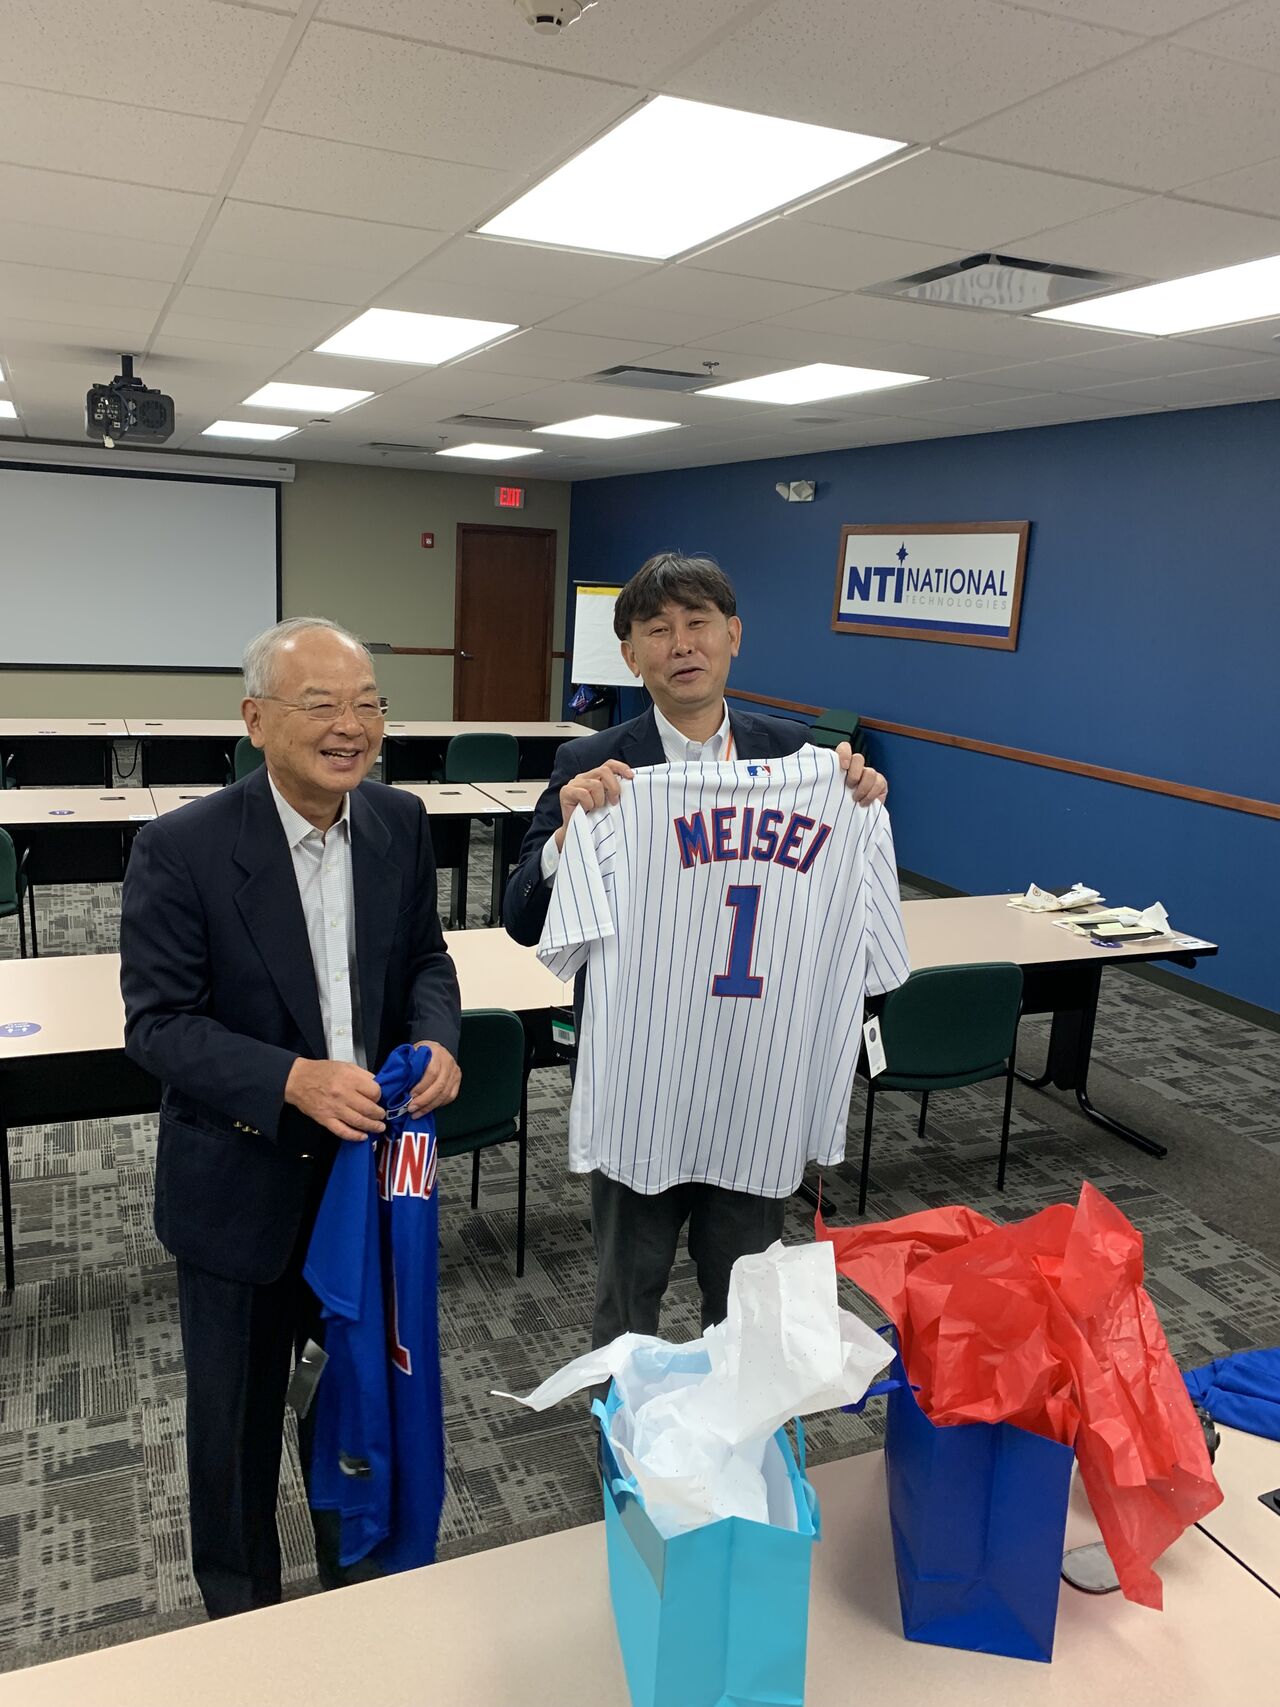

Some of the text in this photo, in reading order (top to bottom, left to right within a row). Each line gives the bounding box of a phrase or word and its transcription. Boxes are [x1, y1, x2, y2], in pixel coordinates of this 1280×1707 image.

[500, 487, 521, 507] EXIT
[906, 567, 1008, 597] NATIONAL
[905, 594, 1007, 610] TECHNOLOGIES
[673, 806, 832, 874] MEISEI
[711, 884, 764, 999] 1
